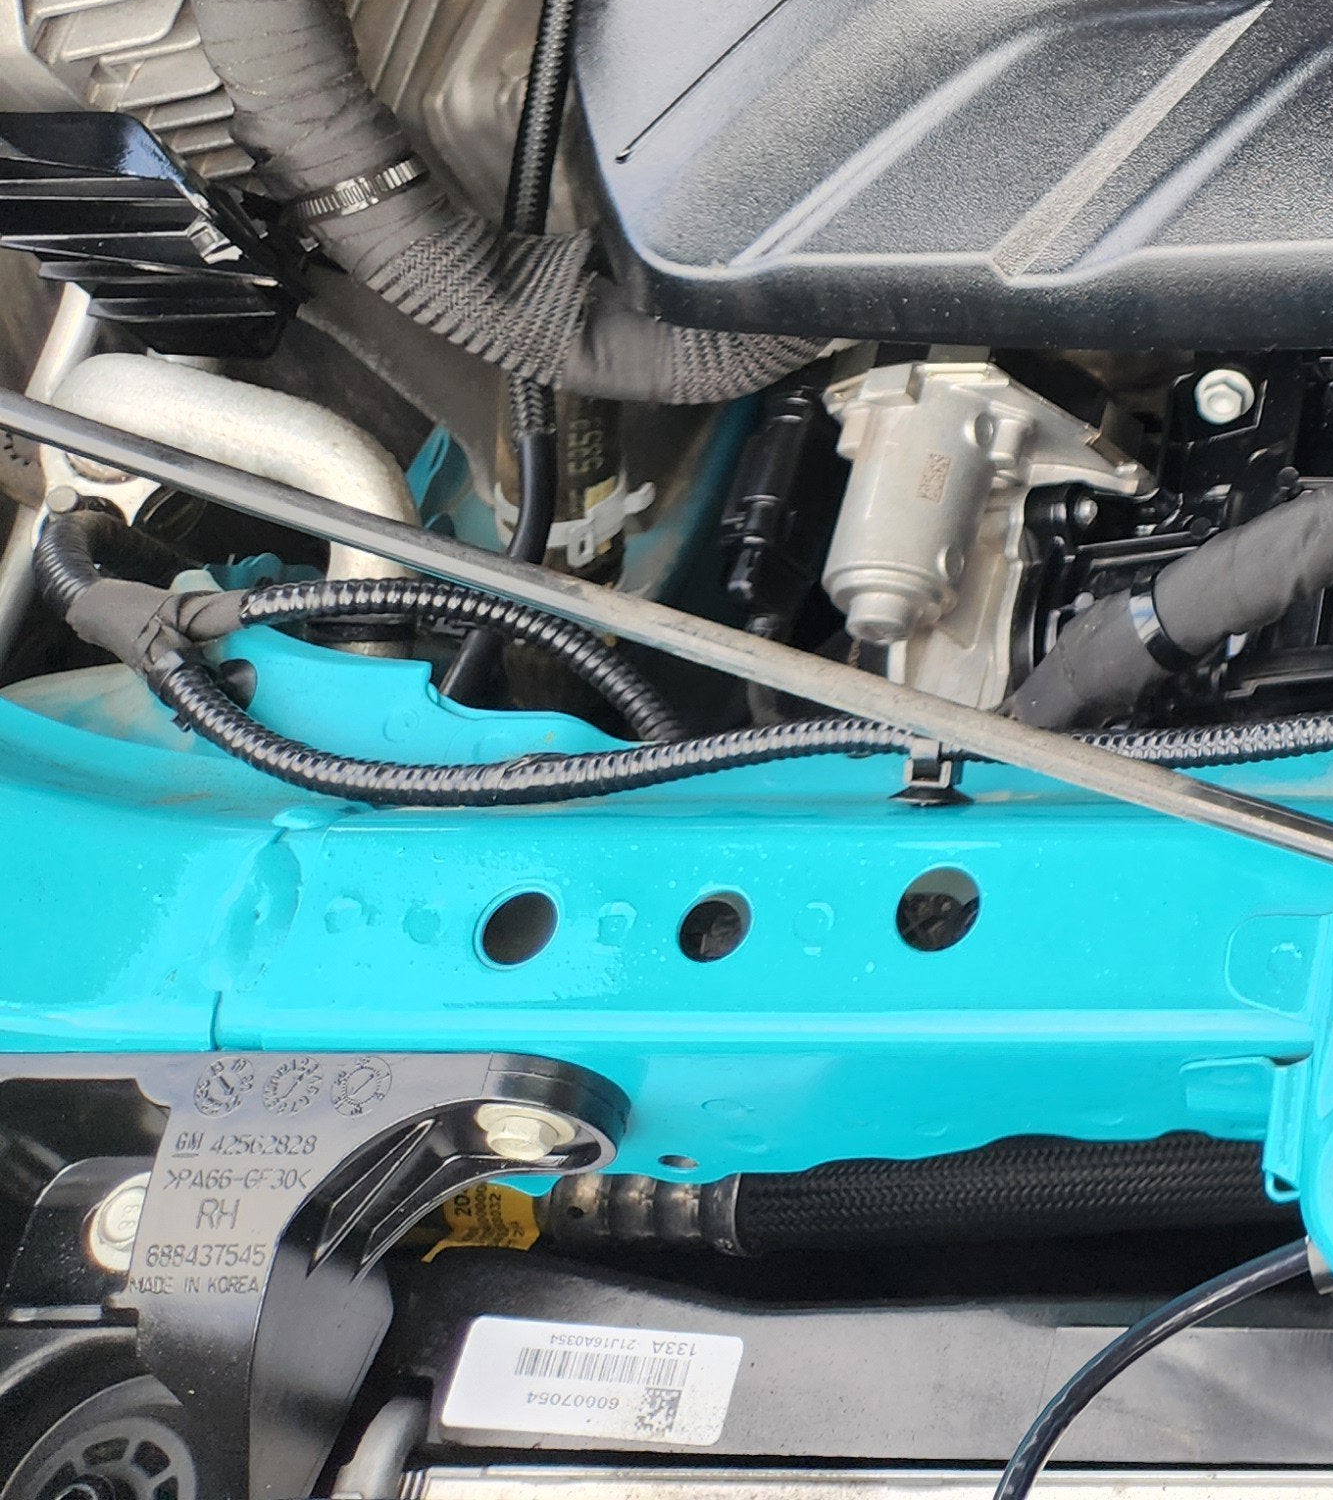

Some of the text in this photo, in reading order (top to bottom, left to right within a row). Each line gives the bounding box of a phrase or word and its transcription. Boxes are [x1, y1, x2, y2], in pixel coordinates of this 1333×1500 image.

[175, 1132, 318, 1155] GM 42562828
[195, 1199, 241, 1230] RH
[129, 1275, 260, 1295] MADE IN KOREA
[549, 1333, 698, 1358] 133A 21J16A0354
[526, 1390, 621, 1411] 60007054
